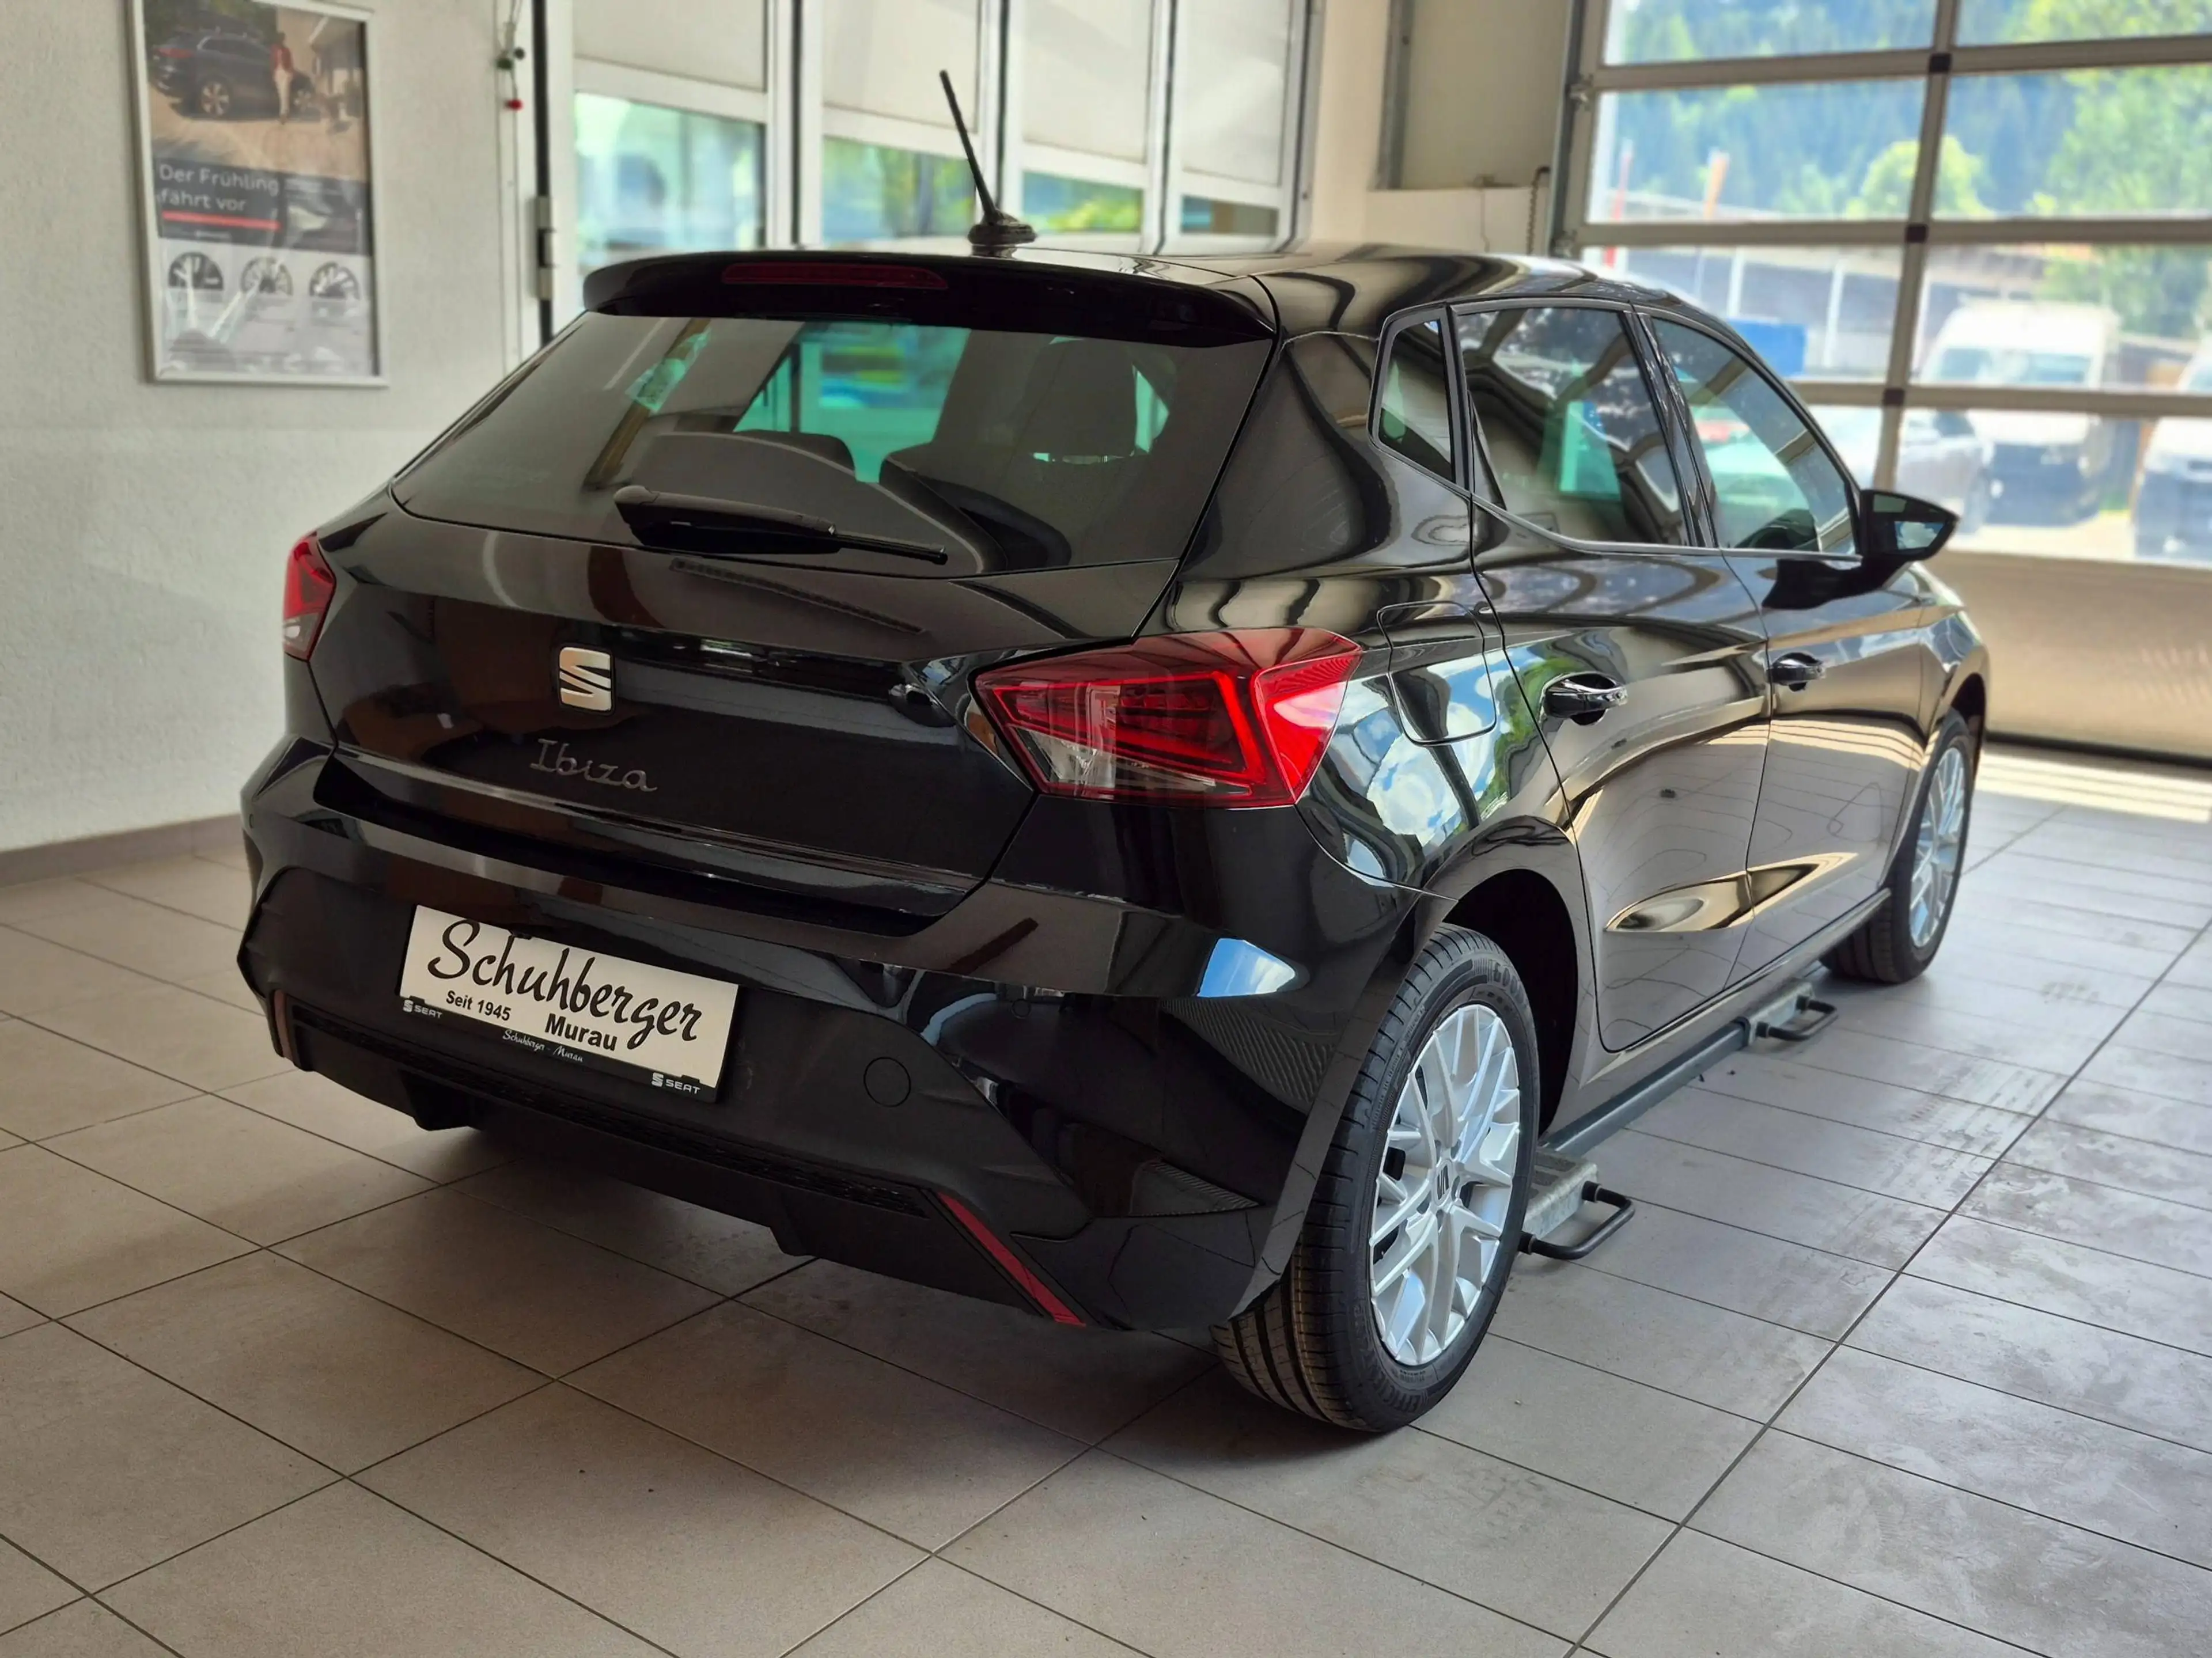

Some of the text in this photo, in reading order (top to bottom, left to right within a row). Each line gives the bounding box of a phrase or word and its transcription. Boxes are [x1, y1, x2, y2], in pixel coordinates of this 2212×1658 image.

[159, 164, 195, 183] Der
[215, 196, 246, 211] vor
[529, 738, 658, 792] Ibiza
[427, 919, 703, 1050] Schuhberger
[414, 1005, 443, 1019] SEAT
[445, 990, 512, 1022] Seit 1945
[544, 1012, 618, 1052] Murau
[553, 1045, 584, 1063] Murau
[665, 1078, 701, 1095] SEAT
